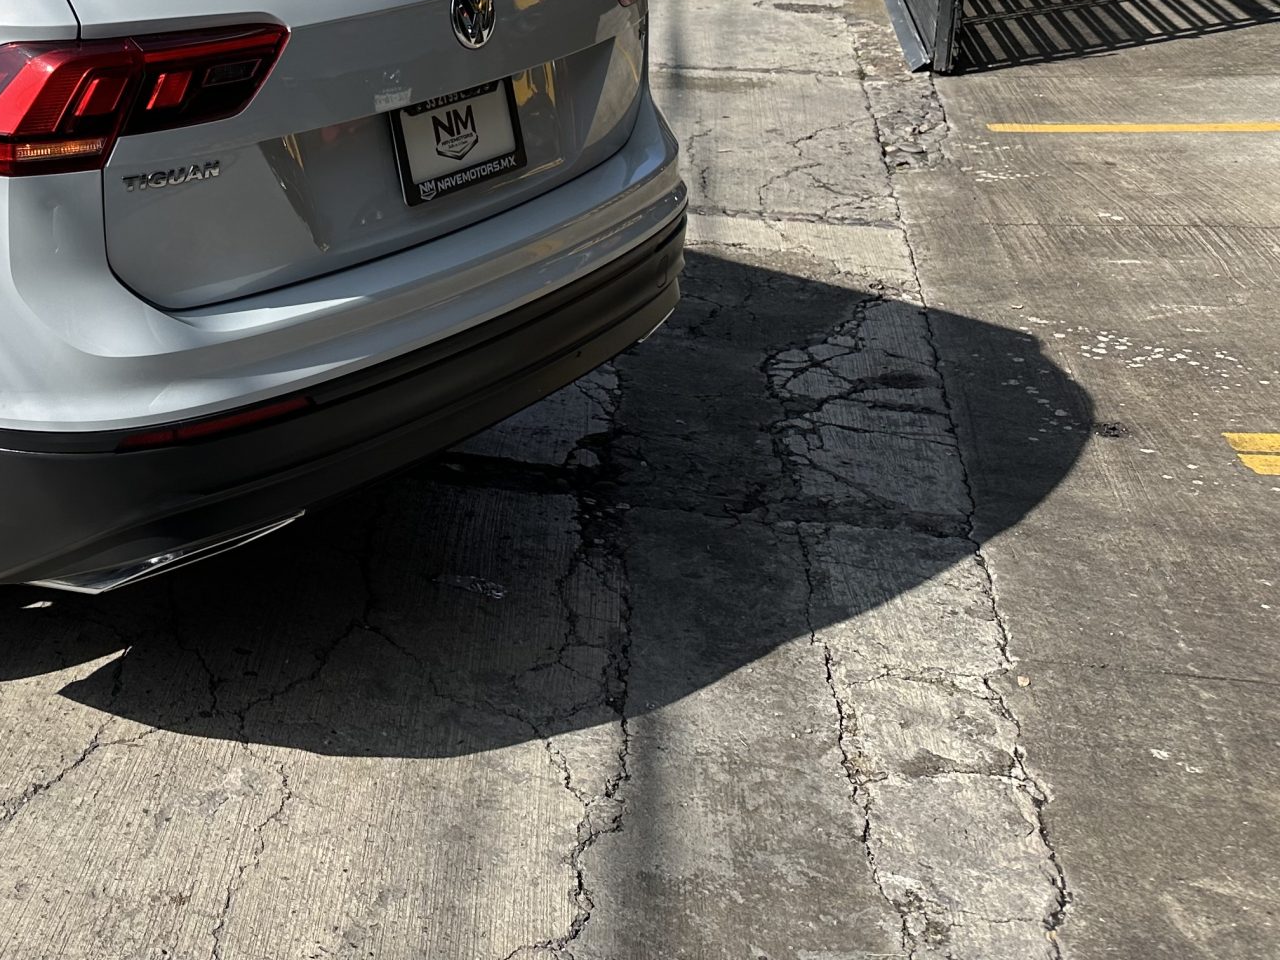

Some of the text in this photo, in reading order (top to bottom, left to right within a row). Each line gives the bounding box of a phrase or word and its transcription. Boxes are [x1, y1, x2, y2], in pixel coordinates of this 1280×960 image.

[431, 104, 477, 146] NM
[122, 160, 220, 192] TIGUAN
[437, 155, 517, 192] NAVEMOTORS.MX
